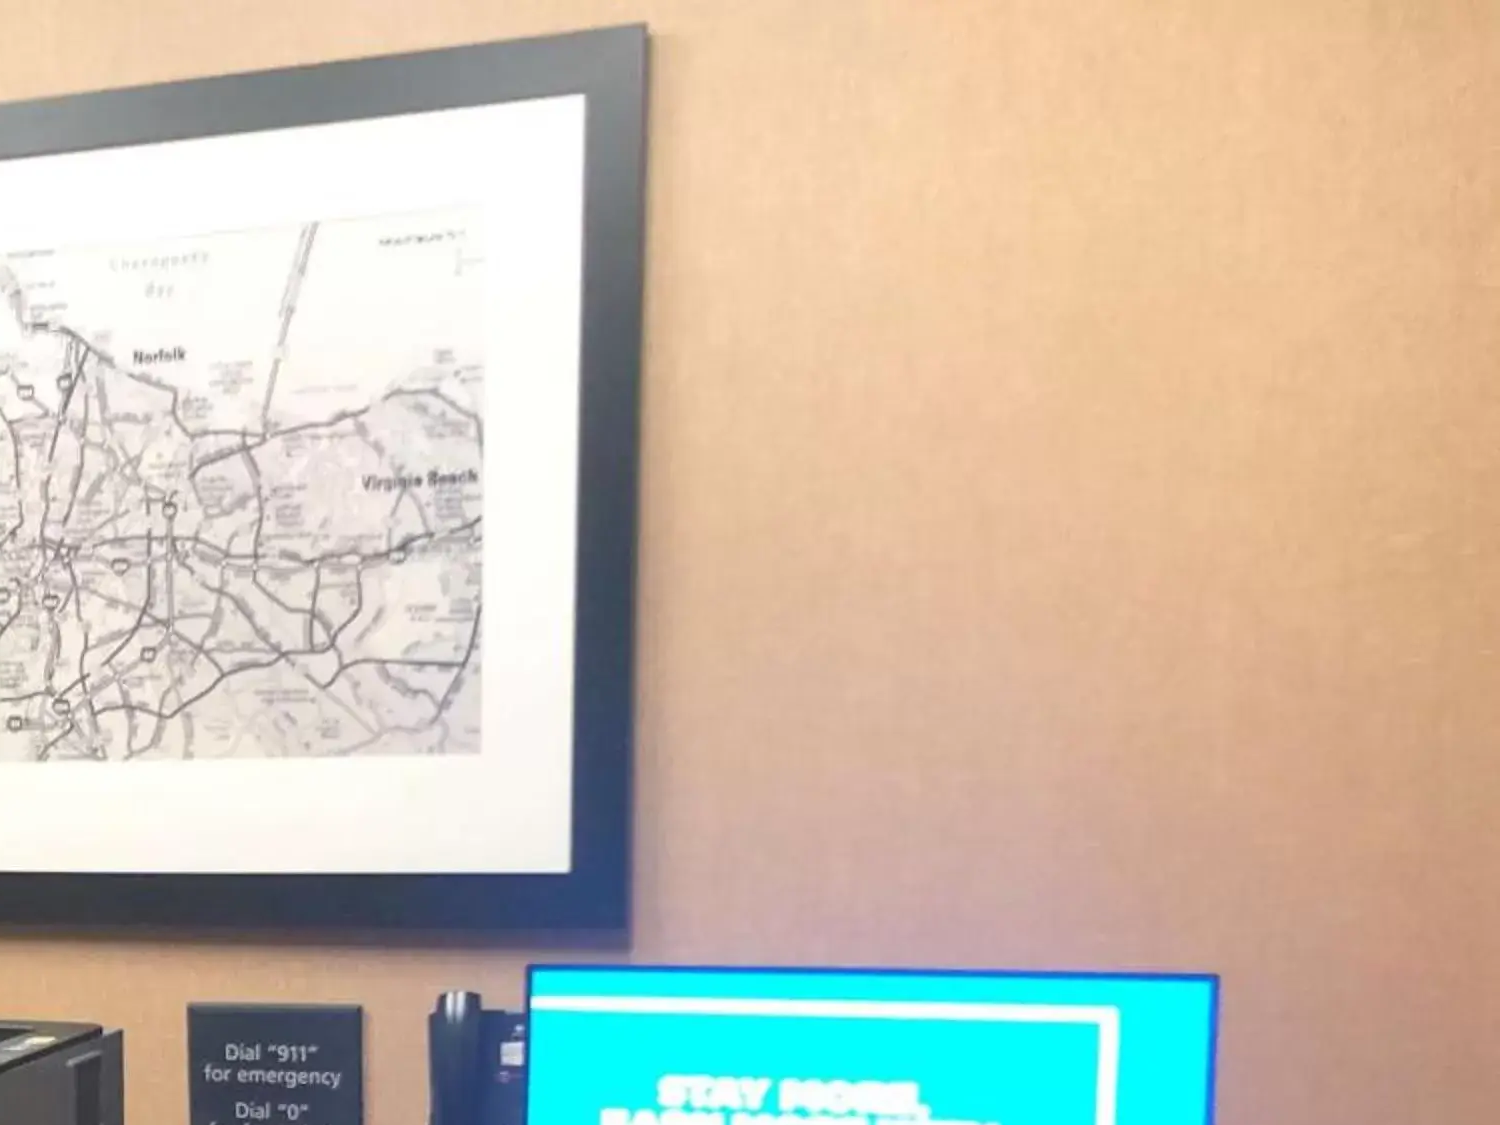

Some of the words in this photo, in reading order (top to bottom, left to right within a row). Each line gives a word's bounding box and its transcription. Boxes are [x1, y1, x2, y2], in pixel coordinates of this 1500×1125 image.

[133, 345, 186, 366] Norfolk
[361, 472, 423, 492] Virginia
[225, 1043, 261, 1061] Dial
[203, 1064, 230, 1082] for
[237, 1066, 342, 1090] emergency
[656, 1074, 773, 1112] STAY
[235, 1101, 271, 1120] Dial
